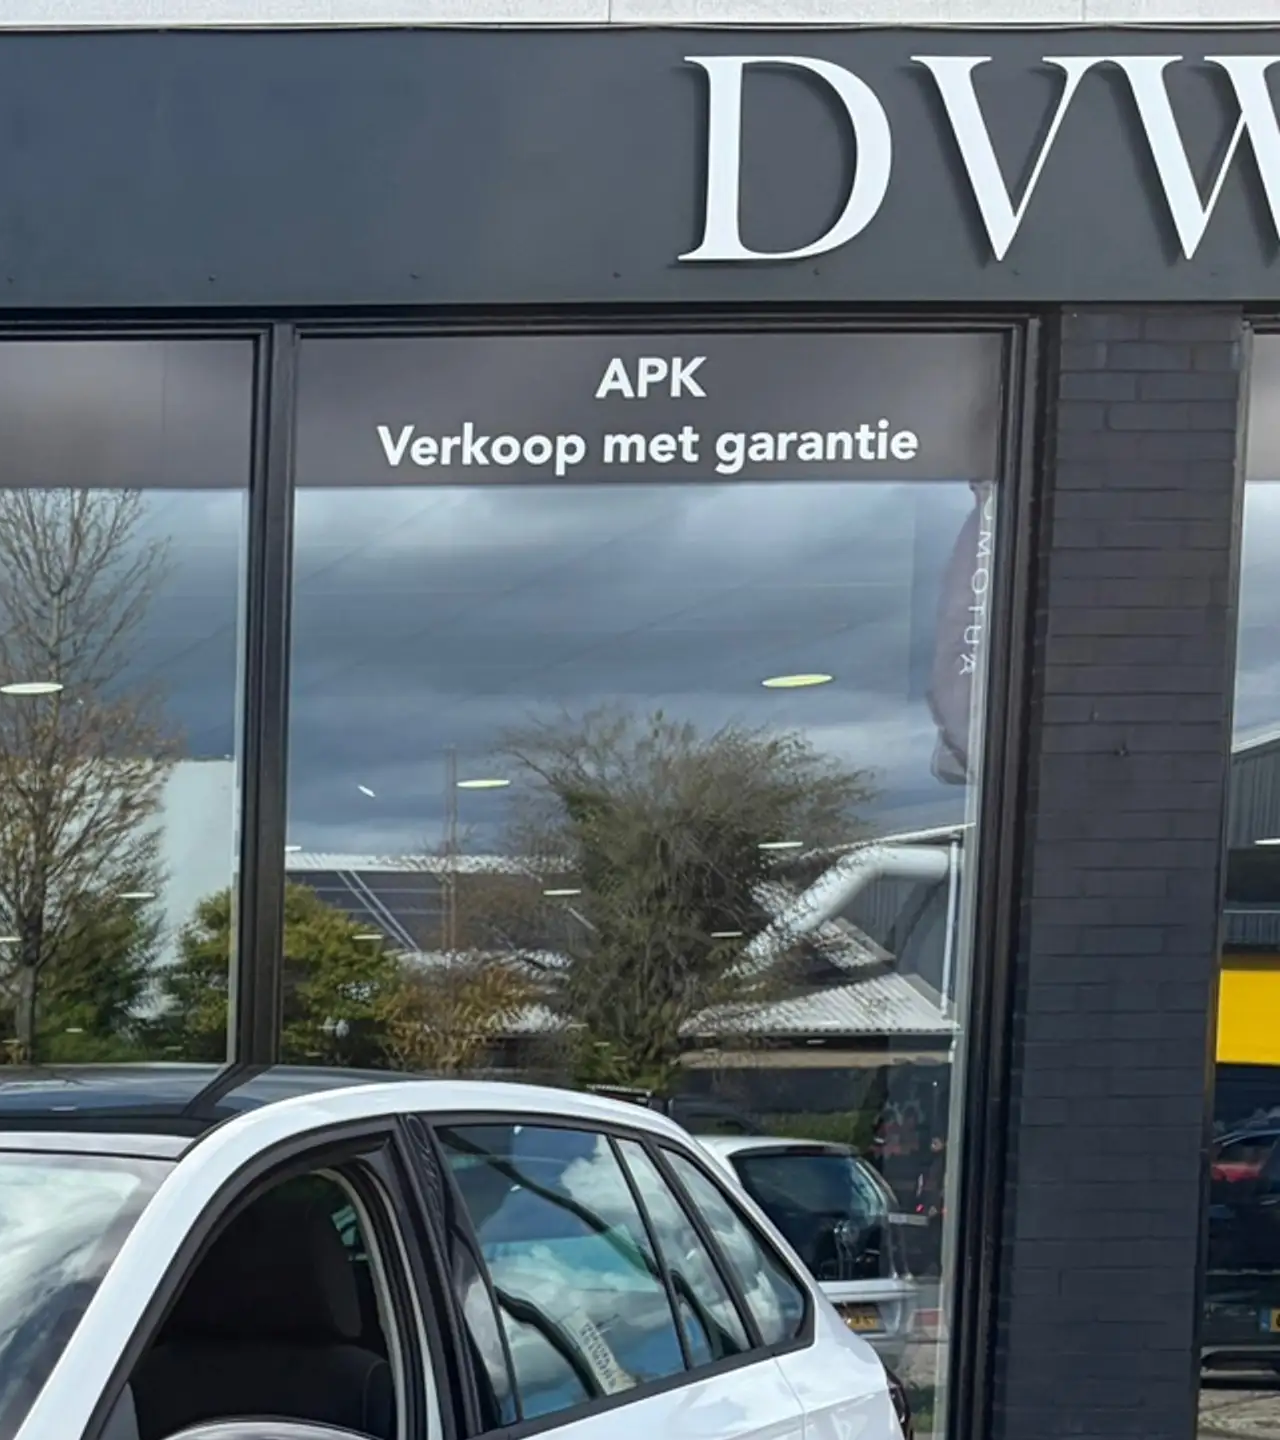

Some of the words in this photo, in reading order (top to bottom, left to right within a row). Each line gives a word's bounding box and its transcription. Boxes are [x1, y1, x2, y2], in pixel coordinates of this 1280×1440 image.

[596, 356, 707, 398] APK
[377, 423, 587, 476] Verkoop
[602, 427, 698, 464] met
[715, 420, 919, 474] garantie
